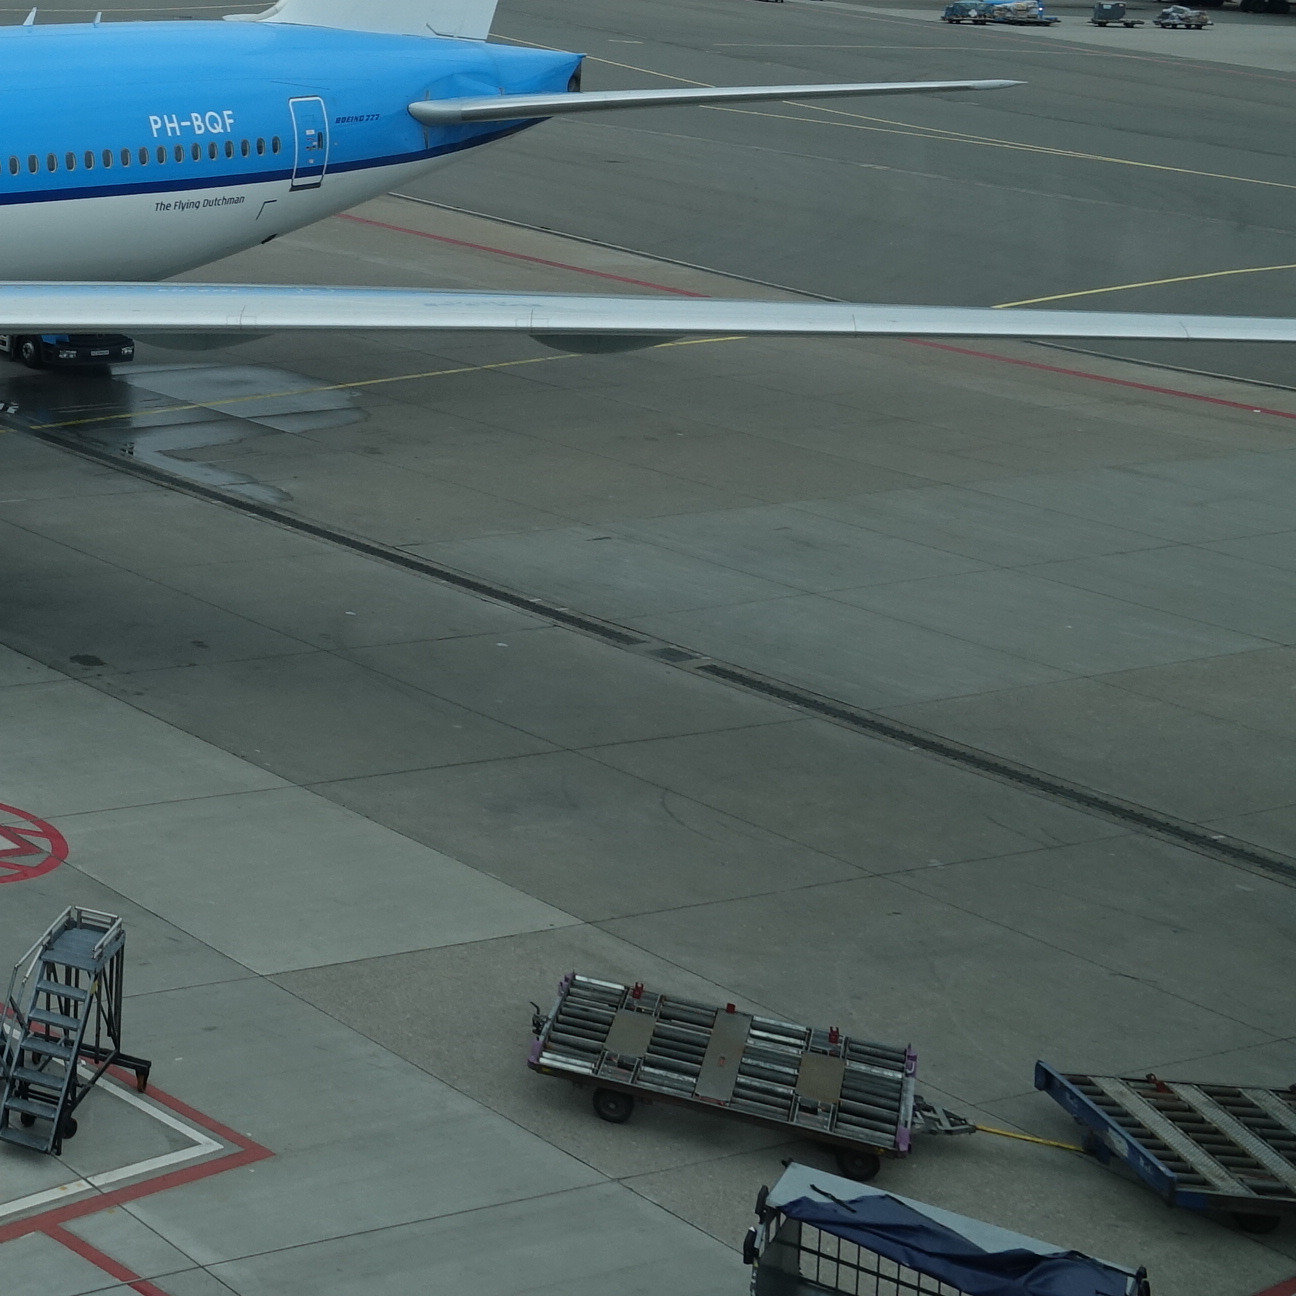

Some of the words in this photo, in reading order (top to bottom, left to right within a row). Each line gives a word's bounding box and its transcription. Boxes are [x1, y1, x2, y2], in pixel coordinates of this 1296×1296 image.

[149, 110, 234, 138] PH-BQF
[336, 115, 364, 124] BOEING
[365, 114, 380, 122] 777
[154, 202, 171, 212] The
[173, 199, 200, 211] Flying
[202, 195, 245, 208] Dutchman
